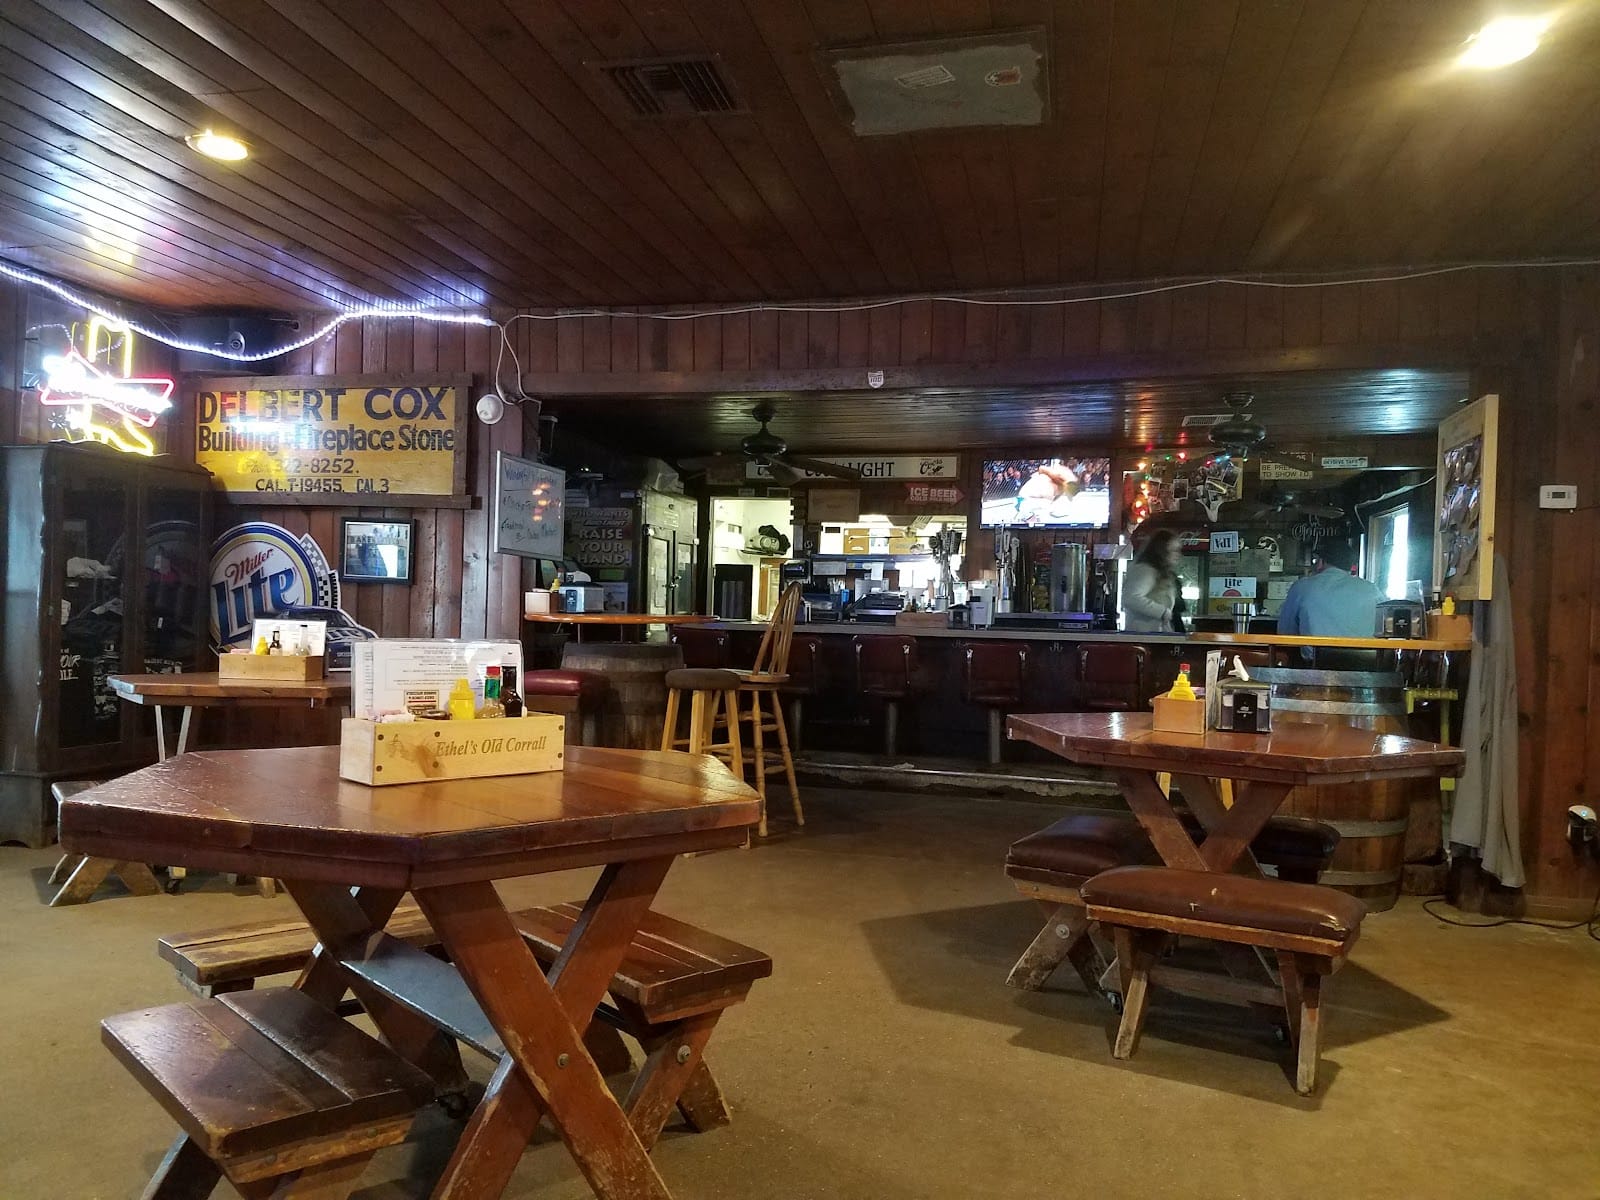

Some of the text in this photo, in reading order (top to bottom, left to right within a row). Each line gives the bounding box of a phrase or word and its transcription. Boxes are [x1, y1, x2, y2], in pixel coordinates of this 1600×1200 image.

[199, 387, 448, 423] DELBERT COX
[199, 425, 278, 456] Building
[398, 423, 454, 451] Stone
[910, 487, 957, 499] ICE BEER
[580, 528, 623, 540] RAISE
[579, 541, 625, 553] YOUR
[225, 548, 273, 586] Miller
[1224, 578, 1242, 588] Lite
[211, 568, 300, 646] Lite
[435, 736, 547, 757] Ethel's Old Corrall
